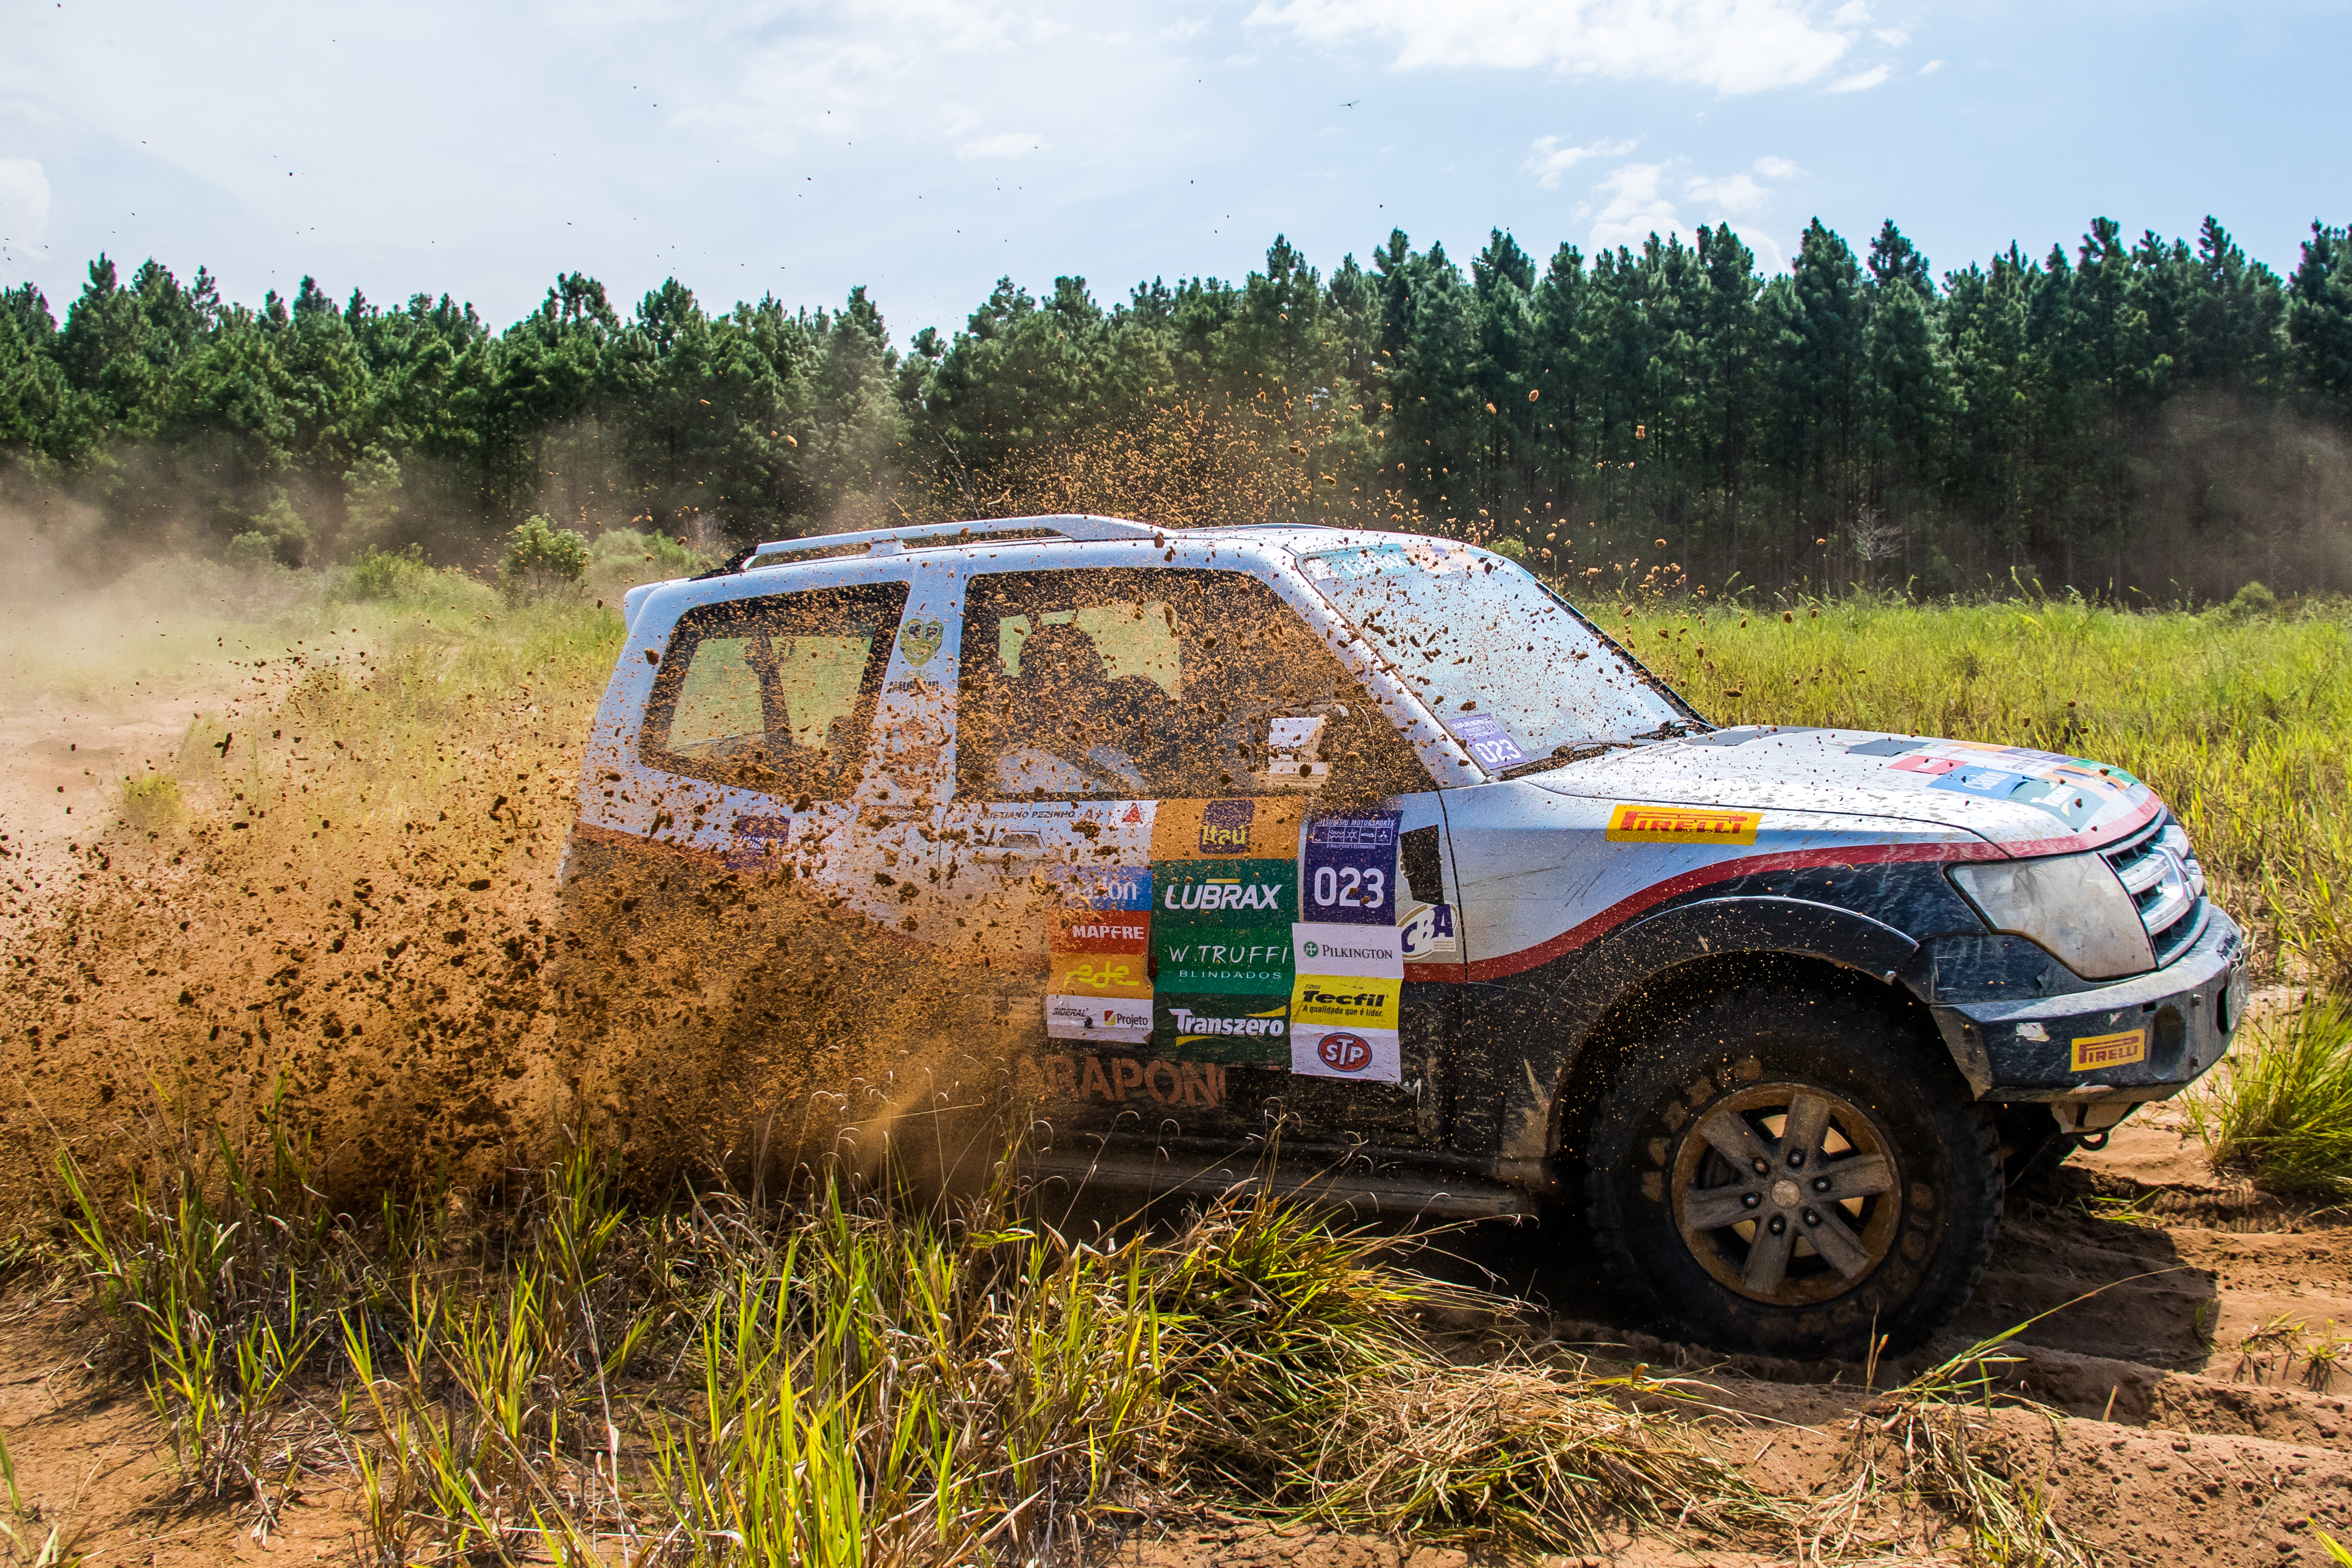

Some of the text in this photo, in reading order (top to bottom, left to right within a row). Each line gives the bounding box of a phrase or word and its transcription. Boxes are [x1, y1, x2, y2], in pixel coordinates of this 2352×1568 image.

[1475, 739, 1521, 763] 023
[1620, 811, 1748, 834] PIRELLI
[1202, 824, 1246, 845] Itaú
[1165, 885, 1282, 910] LUBRAX
[1314, 867, 1384, 908] 023
[1072, 925, 1144, 939] MAPFRE
[1401, 904, 1454, 953] CBA
[1322, 945, 1392, 959] PILKINGTON
[1063, 961, 1140, 988] rede
[1179, 970, 1282, 980] BLINDADOS
[1303, 990, 1385, 1007] Tecfil
[1309, 1005, 1343, 1015] qualidade
[1052, 1007, 1087, 1017] SIDERAL
[1117, 1013, 1148, 1028] Projeto
[1168, 1009, 1284, 1036] Transzero
[1326, 1038, 1364, 1065] STP
[2079, 1036, 2139, 1064] PIRELLI
